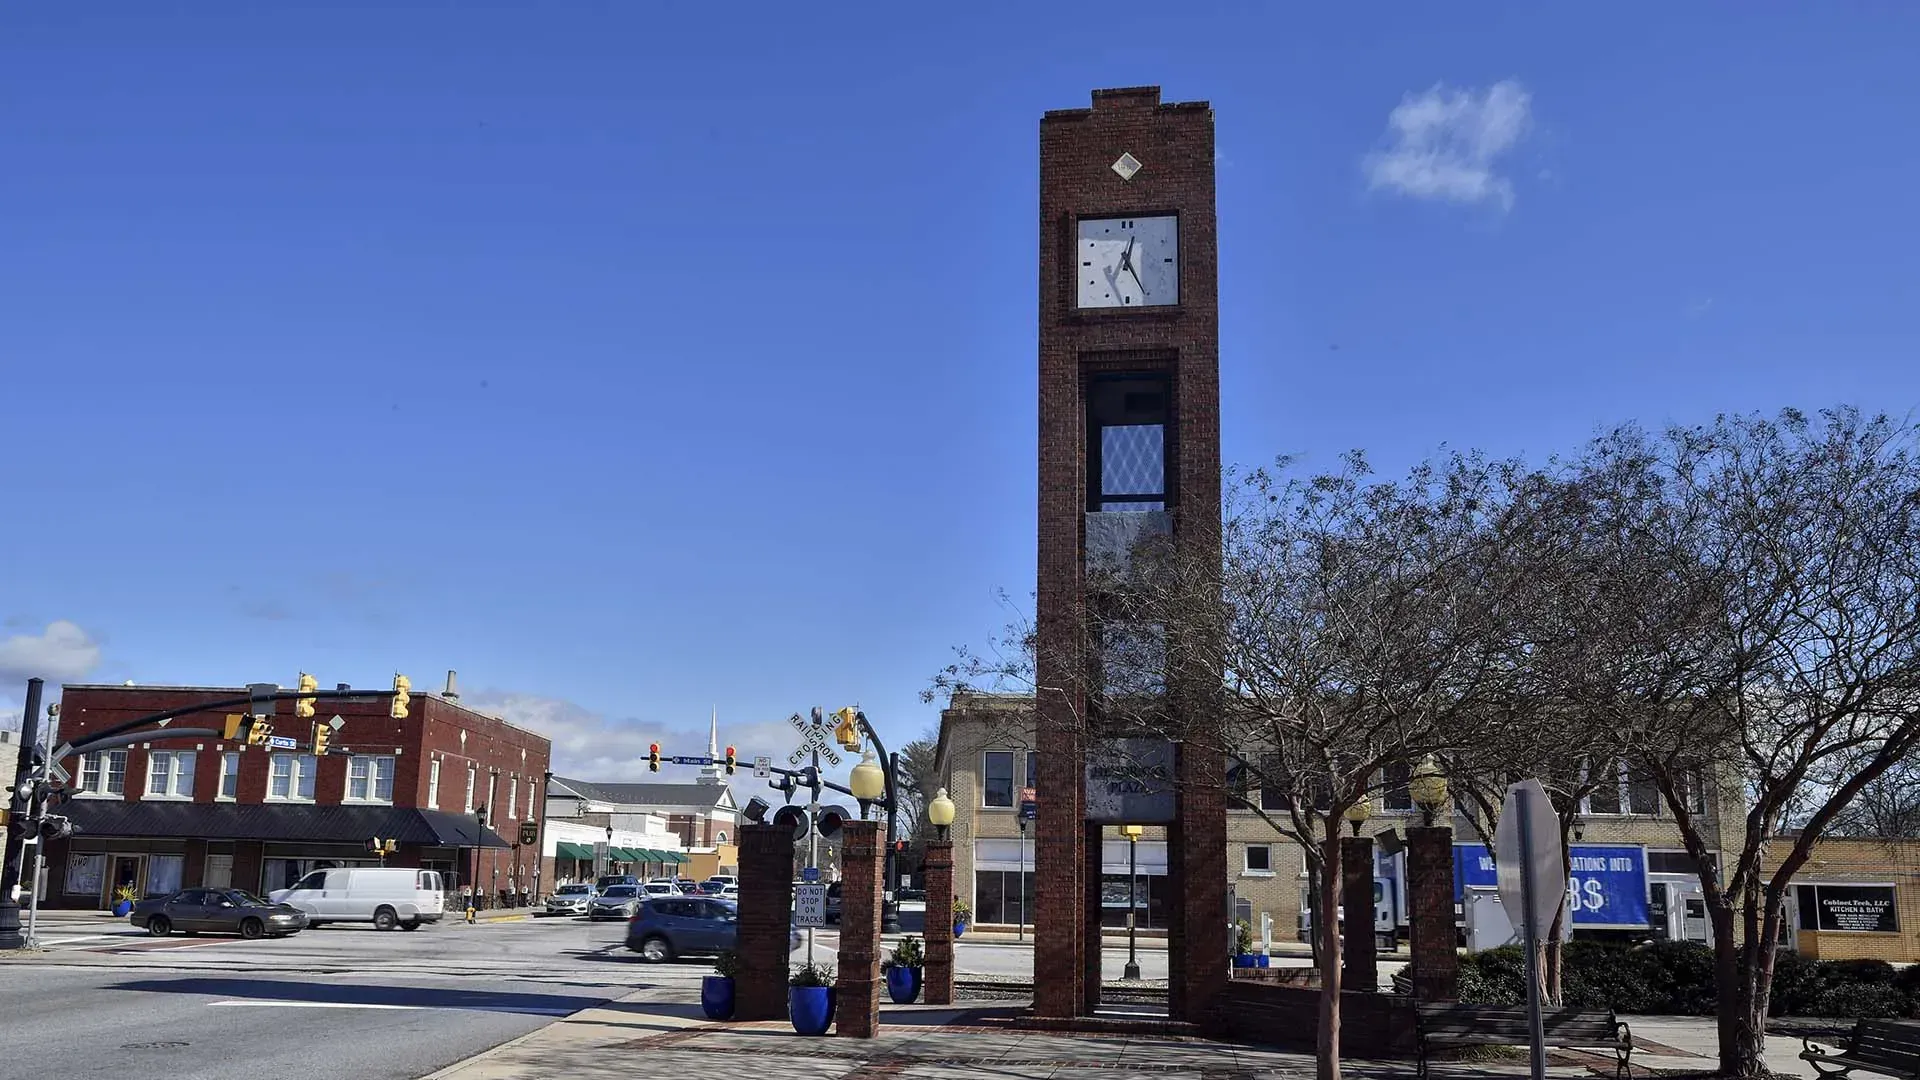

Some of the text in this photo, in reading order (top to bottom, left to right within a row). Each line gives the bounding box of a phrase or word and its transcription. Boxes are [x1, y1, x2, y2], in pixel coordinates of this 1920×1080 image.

[790, 715, 841, 765] CROSSING
[1610, 857, 1632, 871] INTO
[797, 888, 823, 896] DO NOT
[801, 897, 819, 905] STOP
[804, 906, 815, 914] ON
[797, 915, 823, 924] TRACKS
